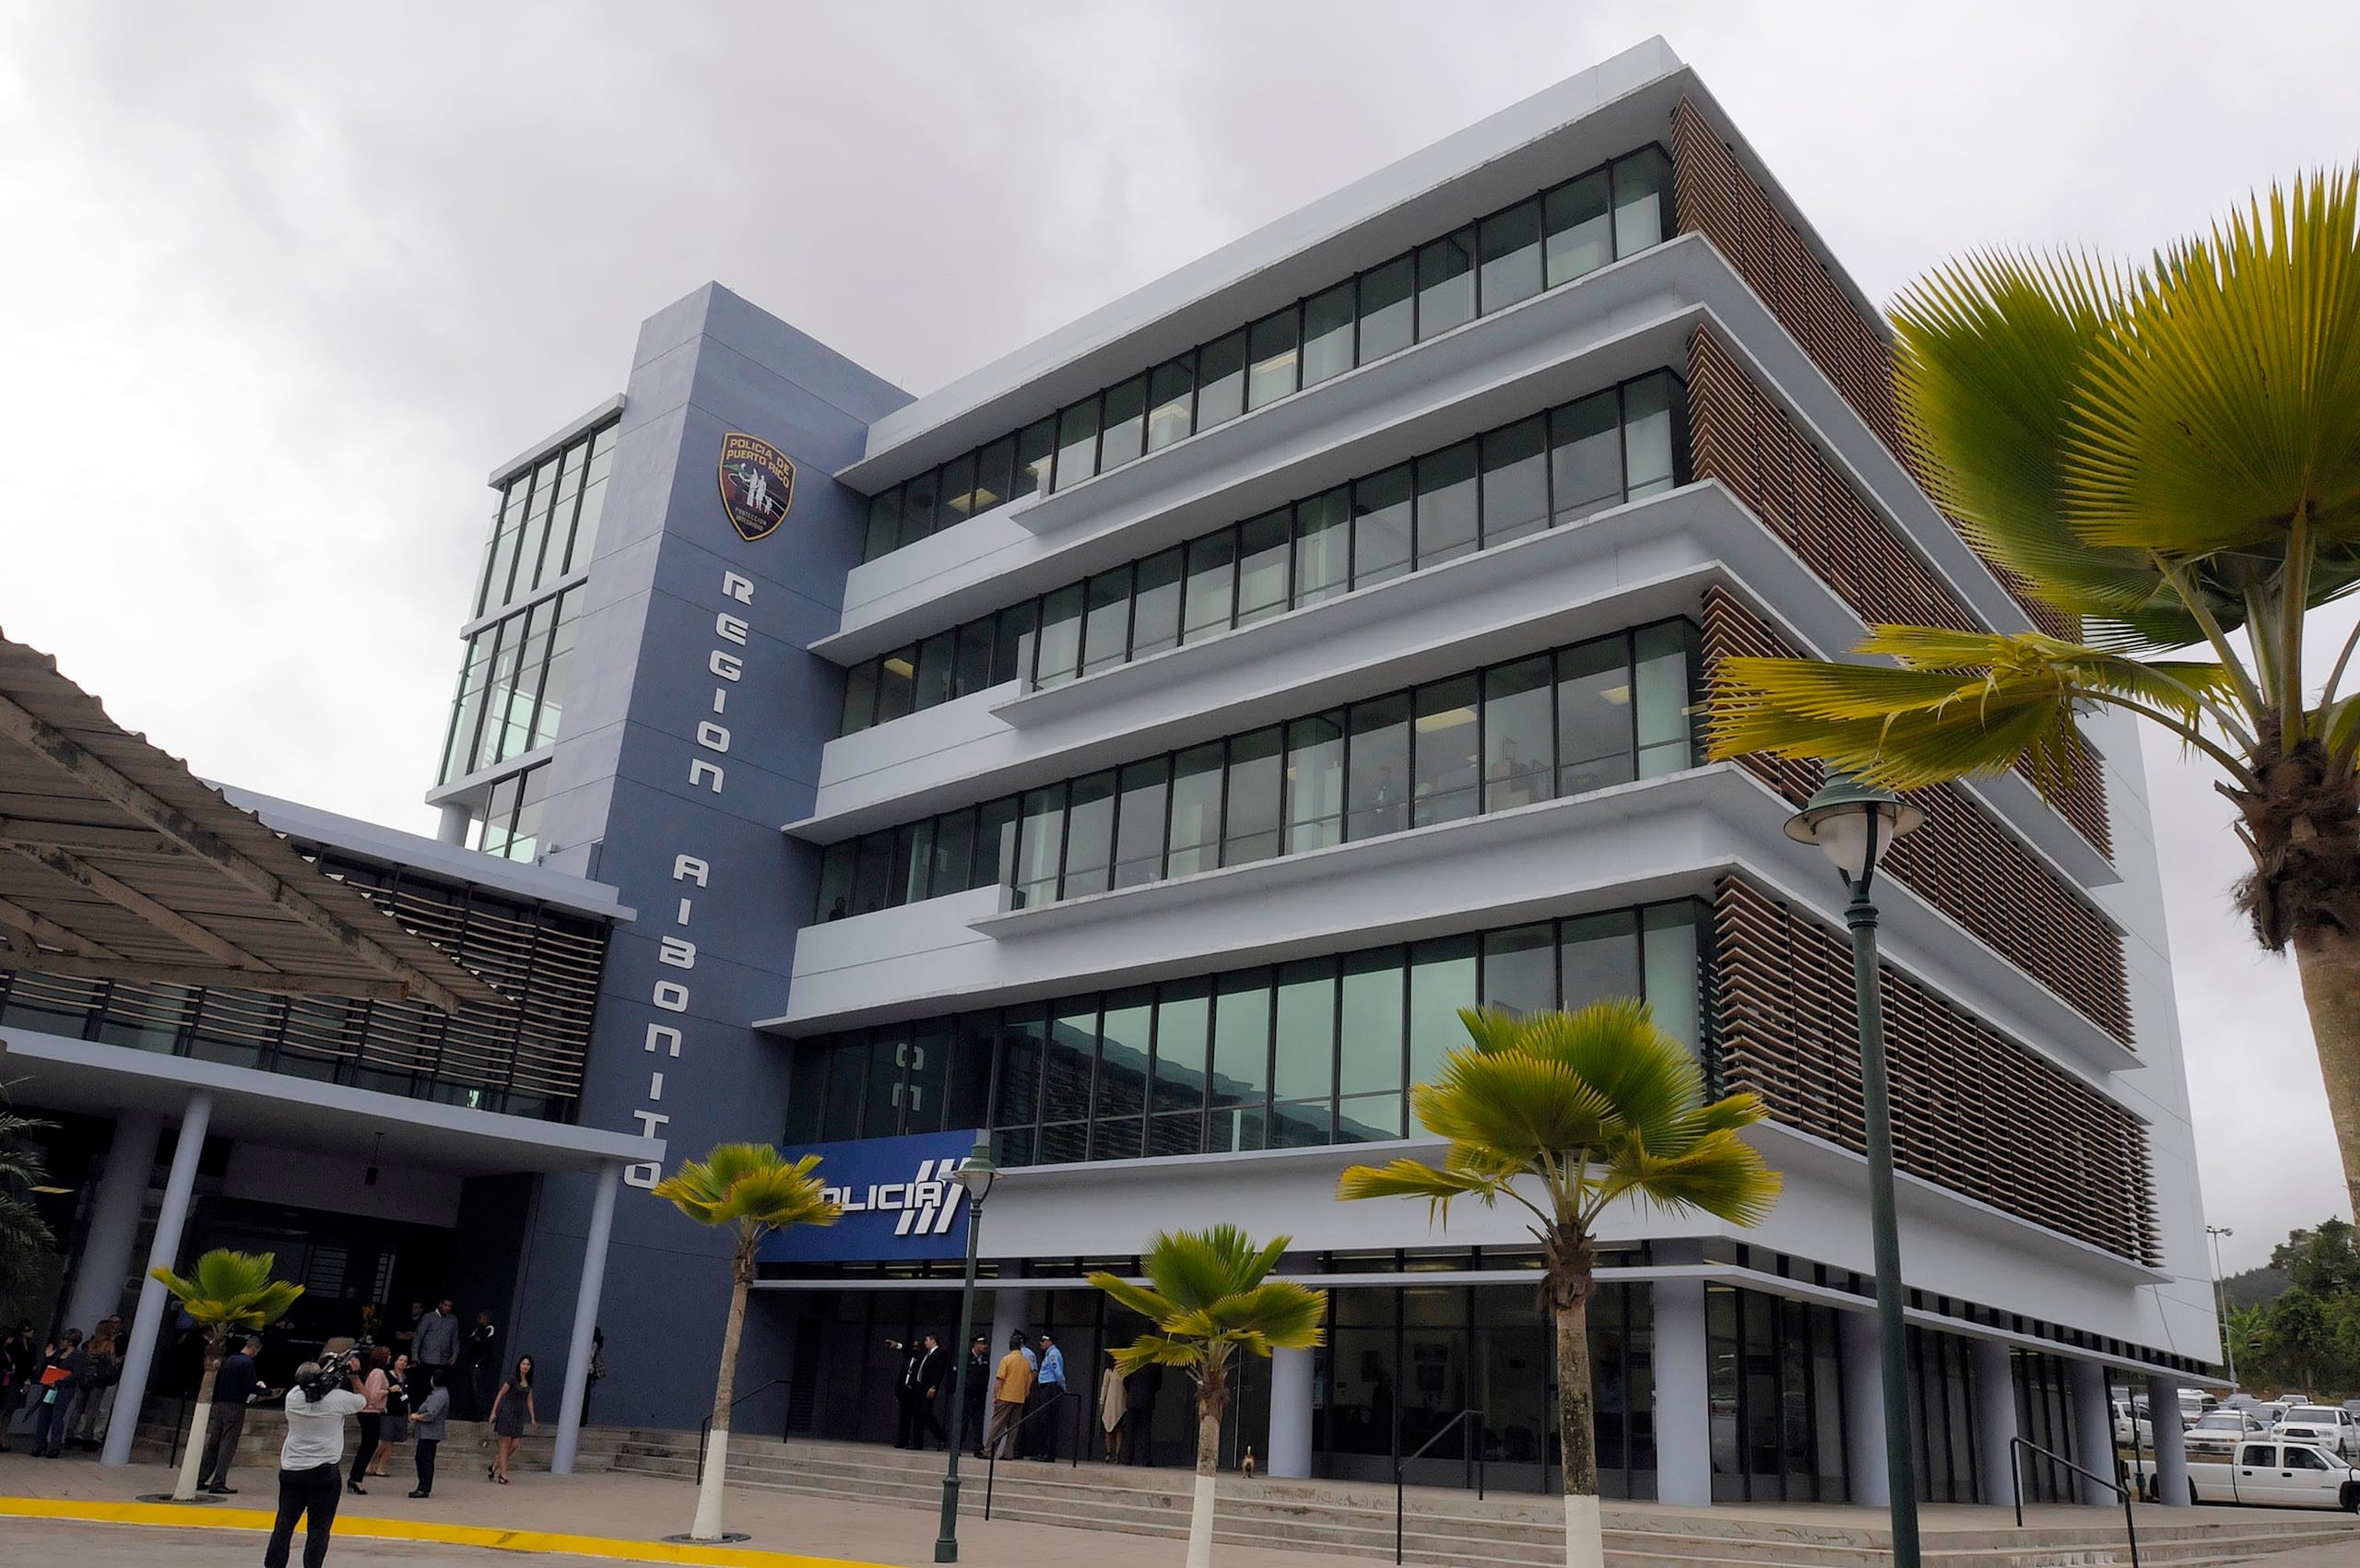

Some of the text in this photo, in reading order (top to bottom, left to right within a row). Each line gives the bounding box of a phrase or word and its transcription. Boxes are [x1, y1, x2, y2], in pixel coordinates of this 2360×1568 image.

[726, 450, 789, 489] PUERTO RICO
[729, 439, 790, 476] POLICIA DE
[624, 571, 754, 1190] REGION AIBONITO
[819, 1182, 943, 1210] OLICIA
